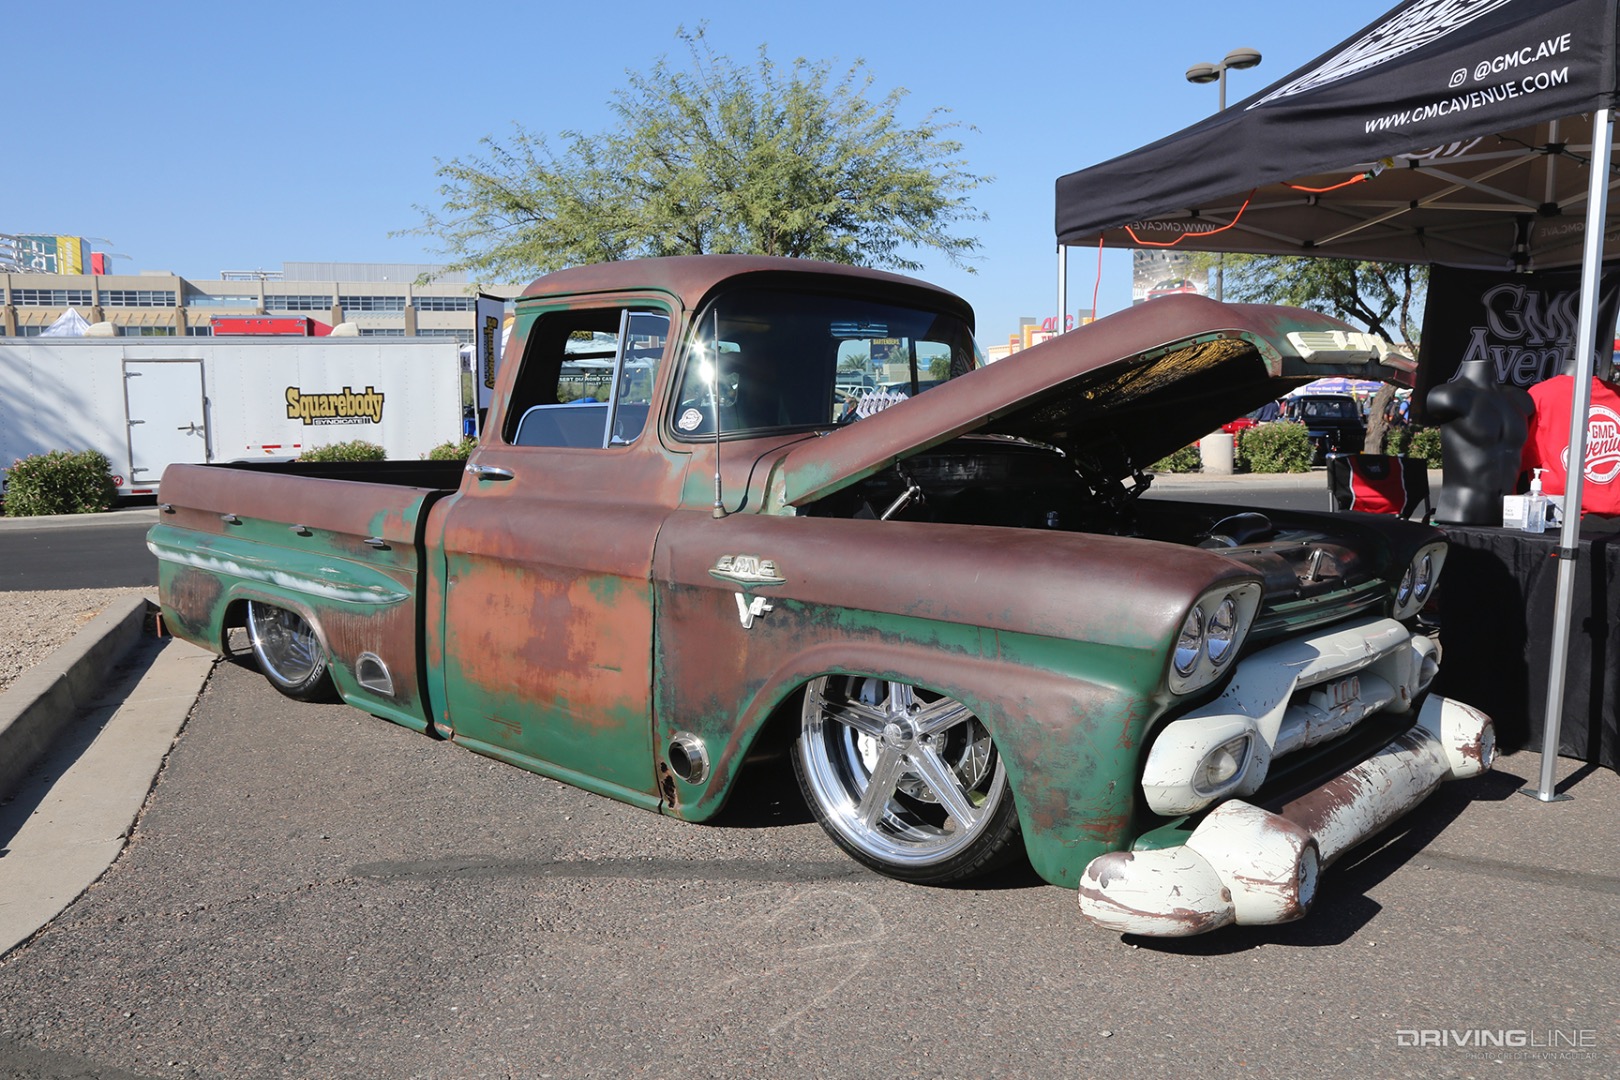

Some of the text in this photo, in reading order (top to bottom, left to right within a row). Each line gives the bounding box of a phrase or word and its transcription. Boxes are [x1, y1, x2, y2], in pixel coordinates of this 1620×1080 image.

[1473, 33, 1571, 81] @GMC.AVE
[1365, 67, 1569, 134] WWW.GMCAVENUE.COM
[1449, 327, 1600, 387] Aven
[285, 386, 385, 425] Squarebody
[1586, 437, 1620, 458] venu
[1592, 425, 1615, 439] GMC
